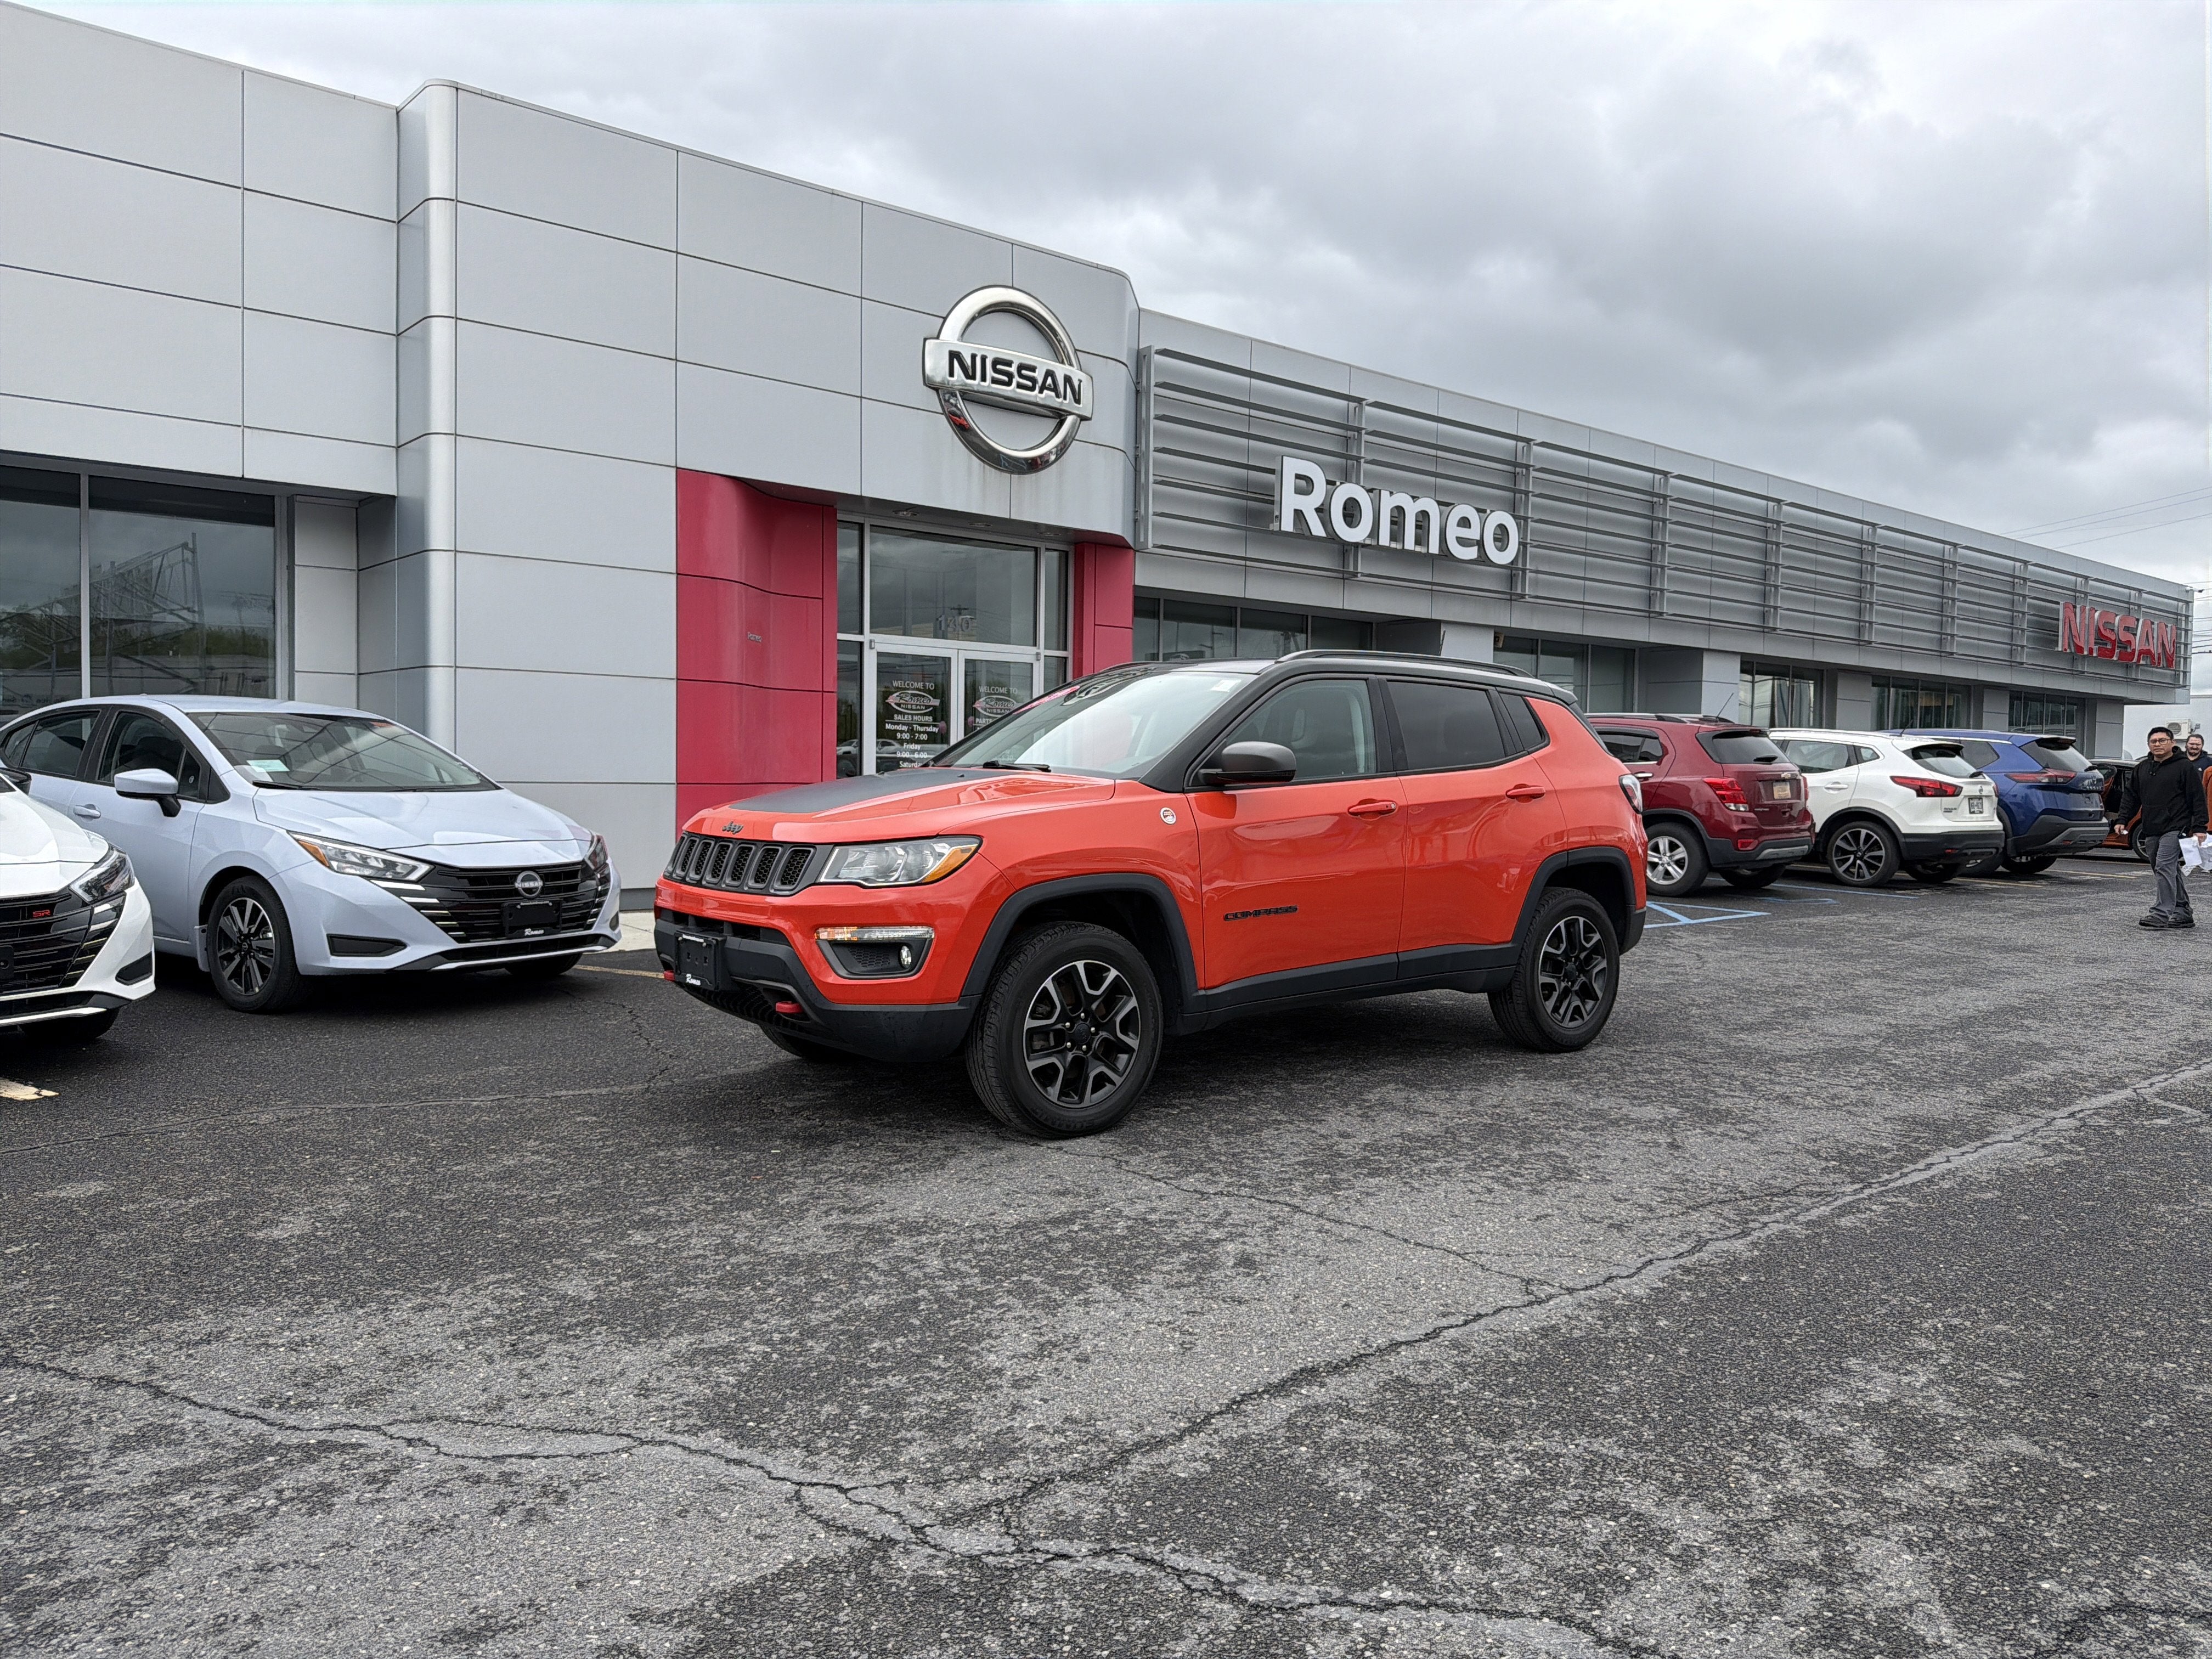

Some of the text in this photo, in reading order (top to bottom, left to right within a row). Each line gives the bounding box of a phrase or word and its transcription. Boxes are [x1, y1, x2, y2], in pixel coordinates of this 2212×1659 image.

[948, 349, 1083, 406] NISSAN
[1280, 455, 1519, 565] Romeo
[2062, 601, 2177, 669] NISSAN
[893, 680, 924, 690] WELCOME
[896, 692, 932, 704] Romeo
[983, 697, 1015, 708] Romeo
[885, 723, 908, 731] Monday
[913, 725, 939, 733] Thursday
[722, 821, 744, 834] Jeep
[1223, 906, 1297, 921] COMPASS
